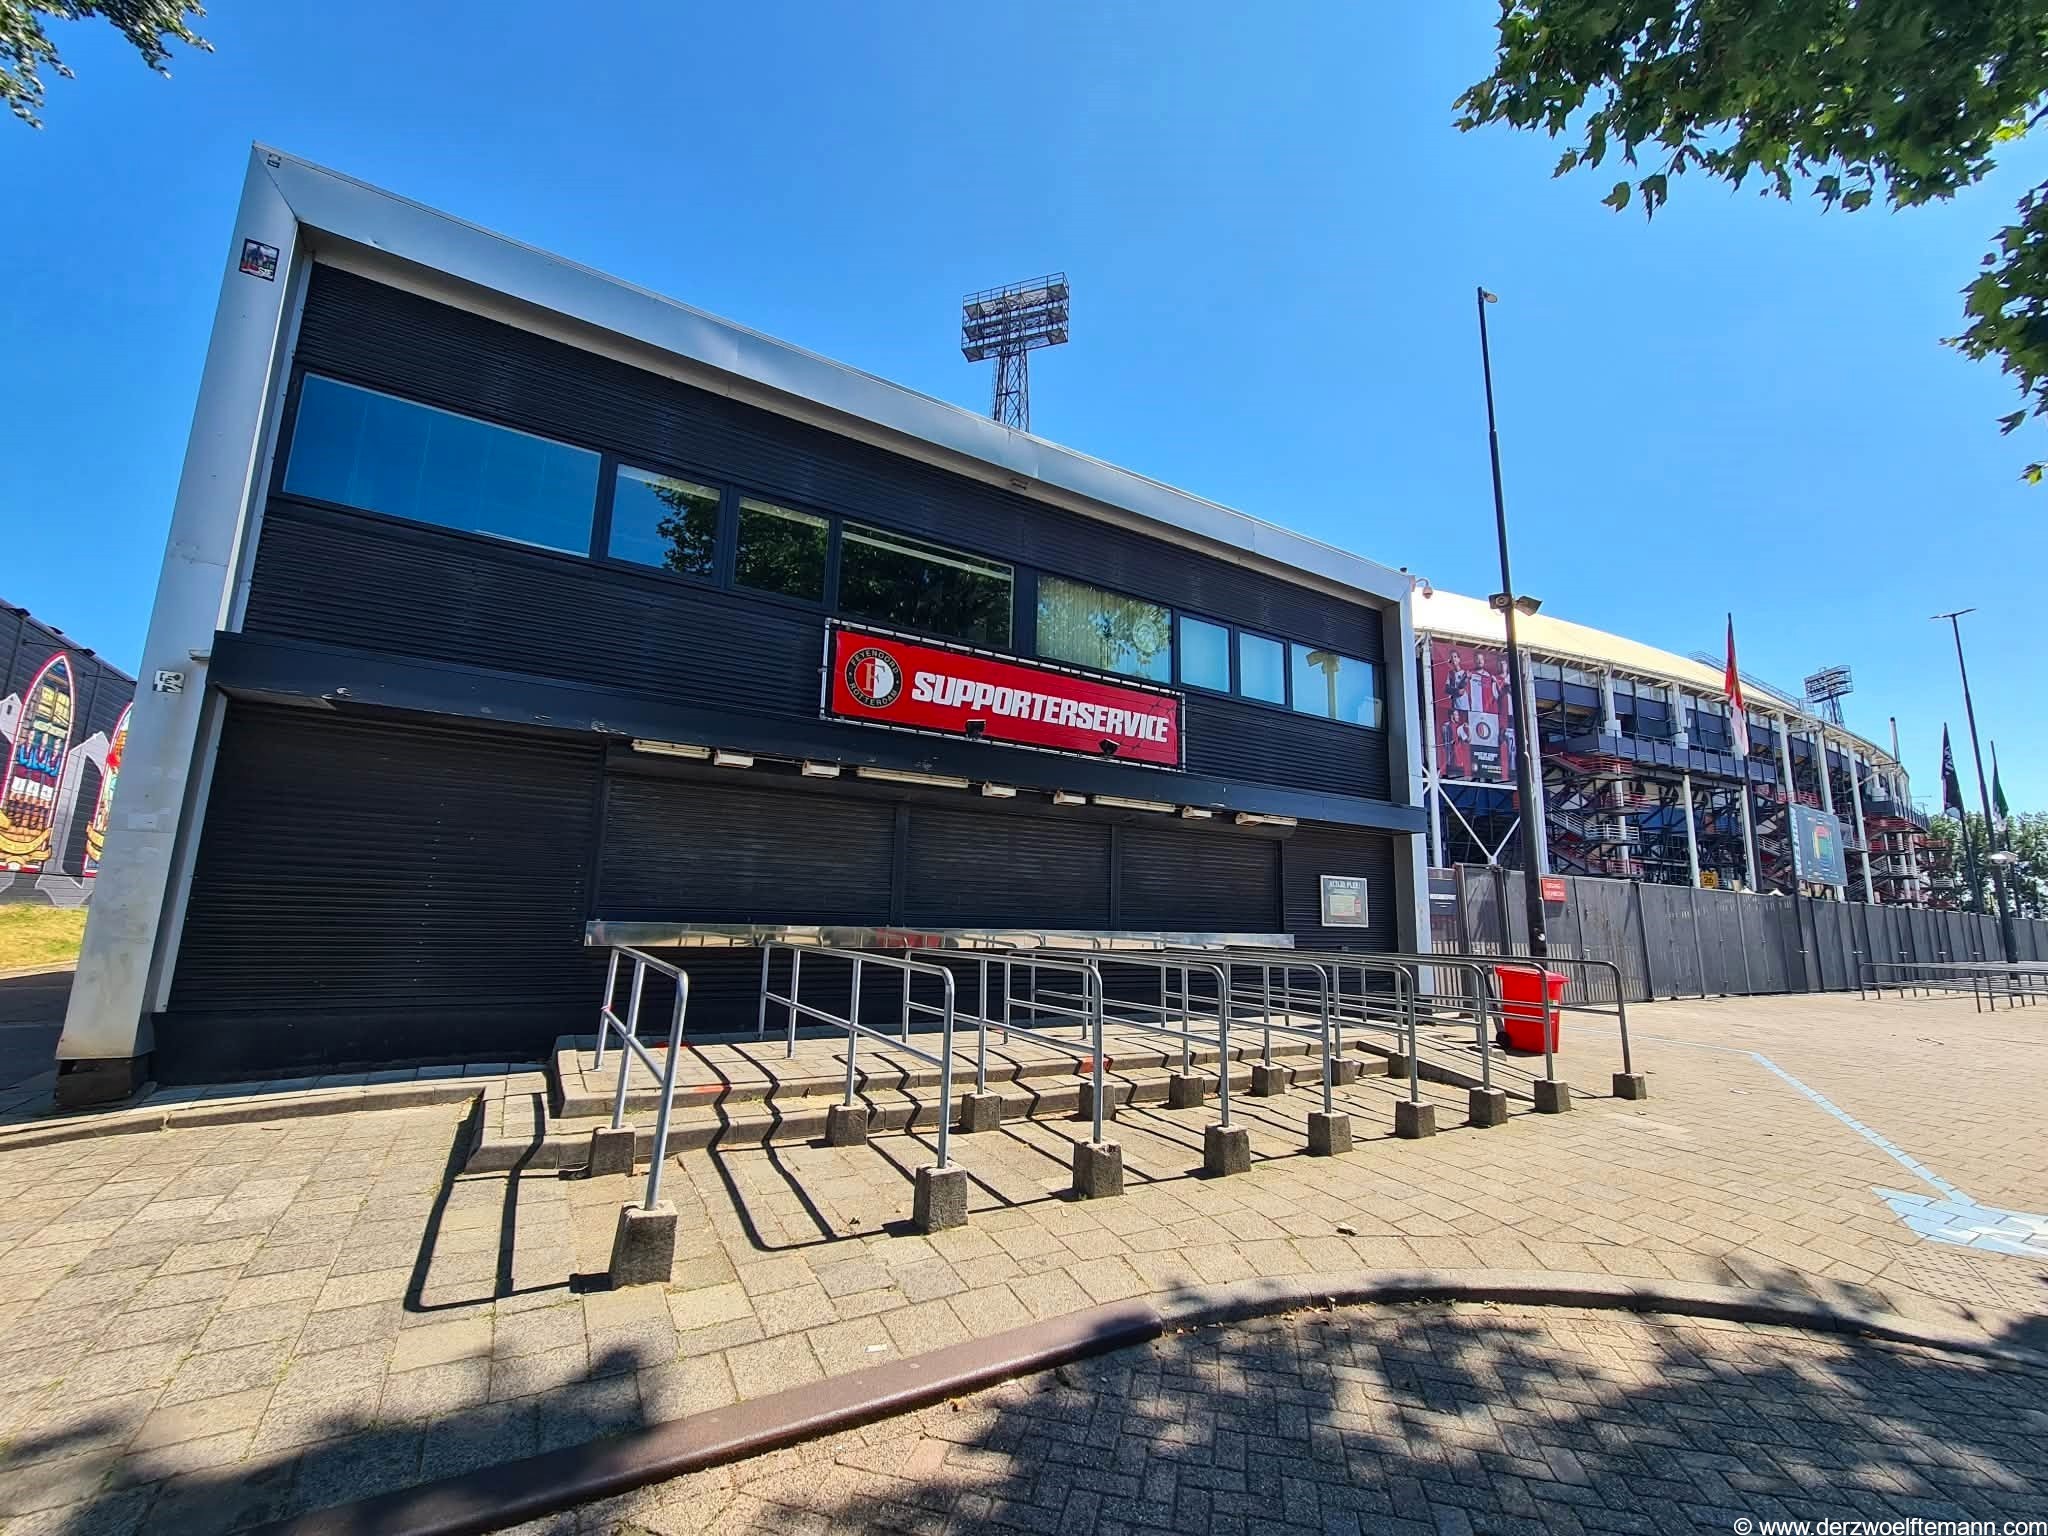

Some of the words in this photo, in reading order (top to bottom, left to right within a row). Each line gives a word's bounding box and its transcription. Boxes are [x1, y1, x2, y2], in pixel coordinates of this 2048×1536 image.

[850, 650, 899, 673] FEYENOORD
[850, 682, 898, 706] ROTTERDAM
[911, 671, 1168, 743] SUPPORTERSERVICE
